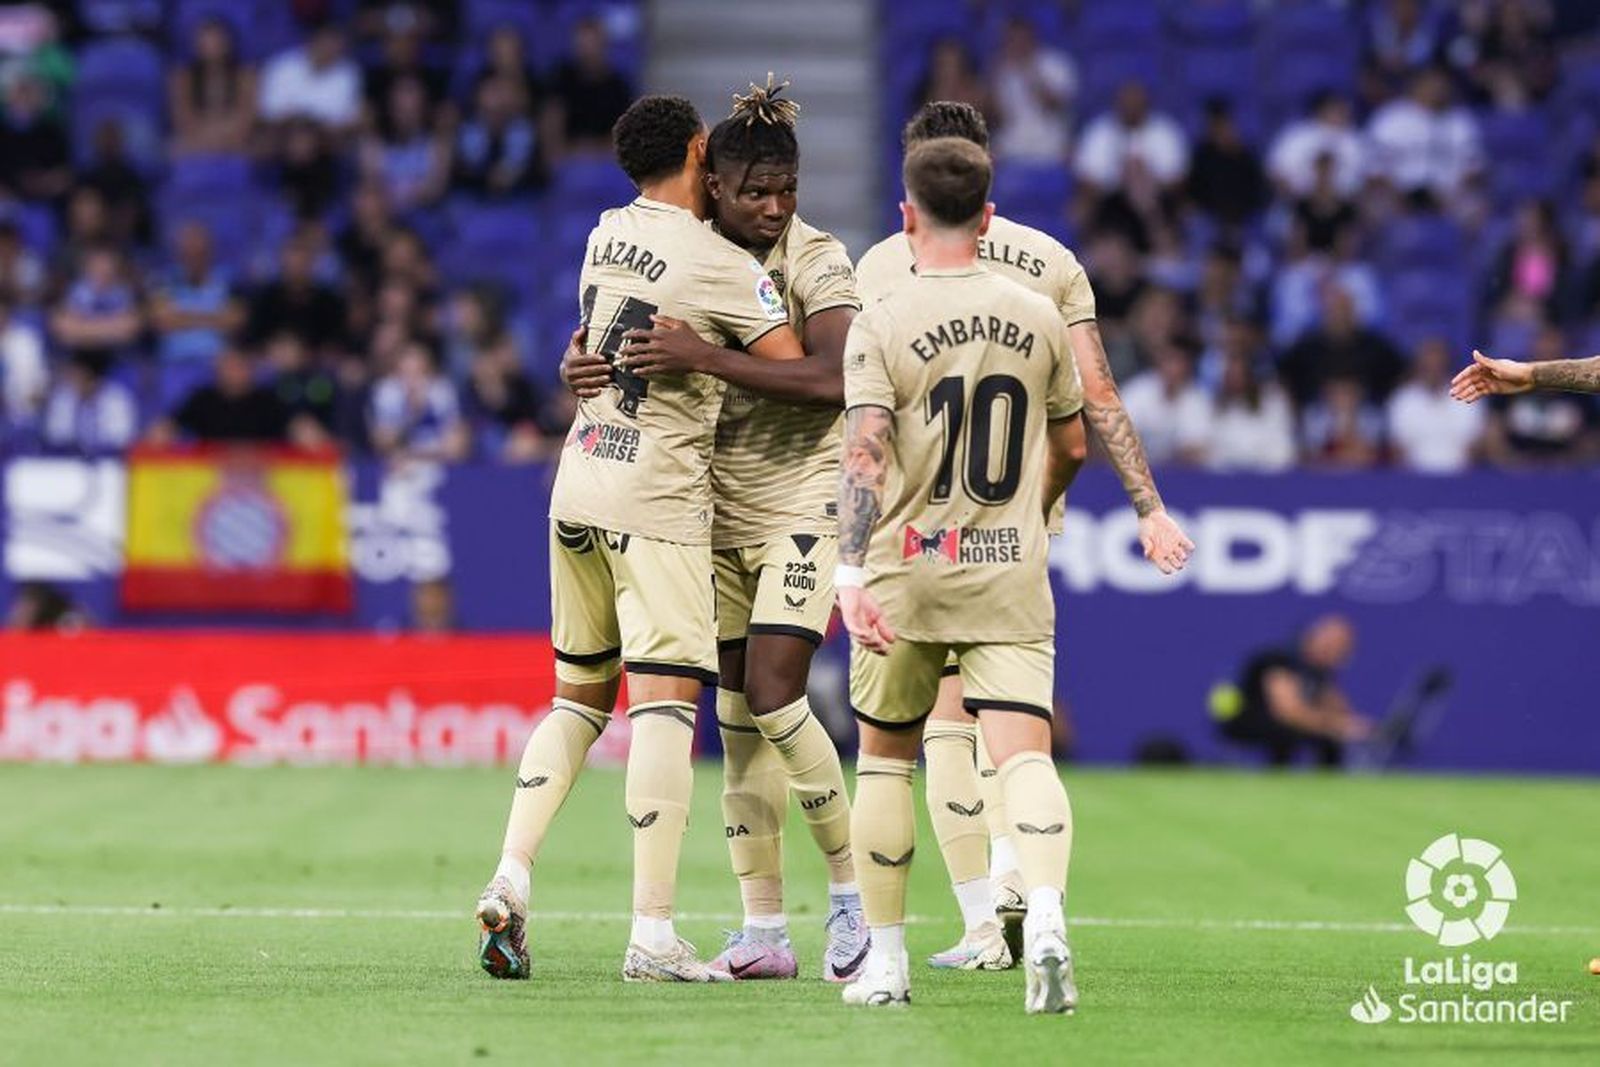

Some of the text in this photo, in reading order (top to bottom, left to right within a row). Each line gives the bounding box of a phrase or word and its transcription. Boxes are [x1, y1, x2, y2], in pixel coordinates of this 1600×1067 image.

[592, 236, 667, 283] LÁZARO
[910, 315, 1035, 365] EMBARBA
[924, 373, 1029, 507] 10
[959, 527, 1019, 546] POWER
[959, 545, 1021, 563] HORSE
[1340, 508, 1600, 607] STA
[783, 574, 815, 591] KUDU
[0, 677, 138, 764] iga
[801, 789, 837, 810] UDA
